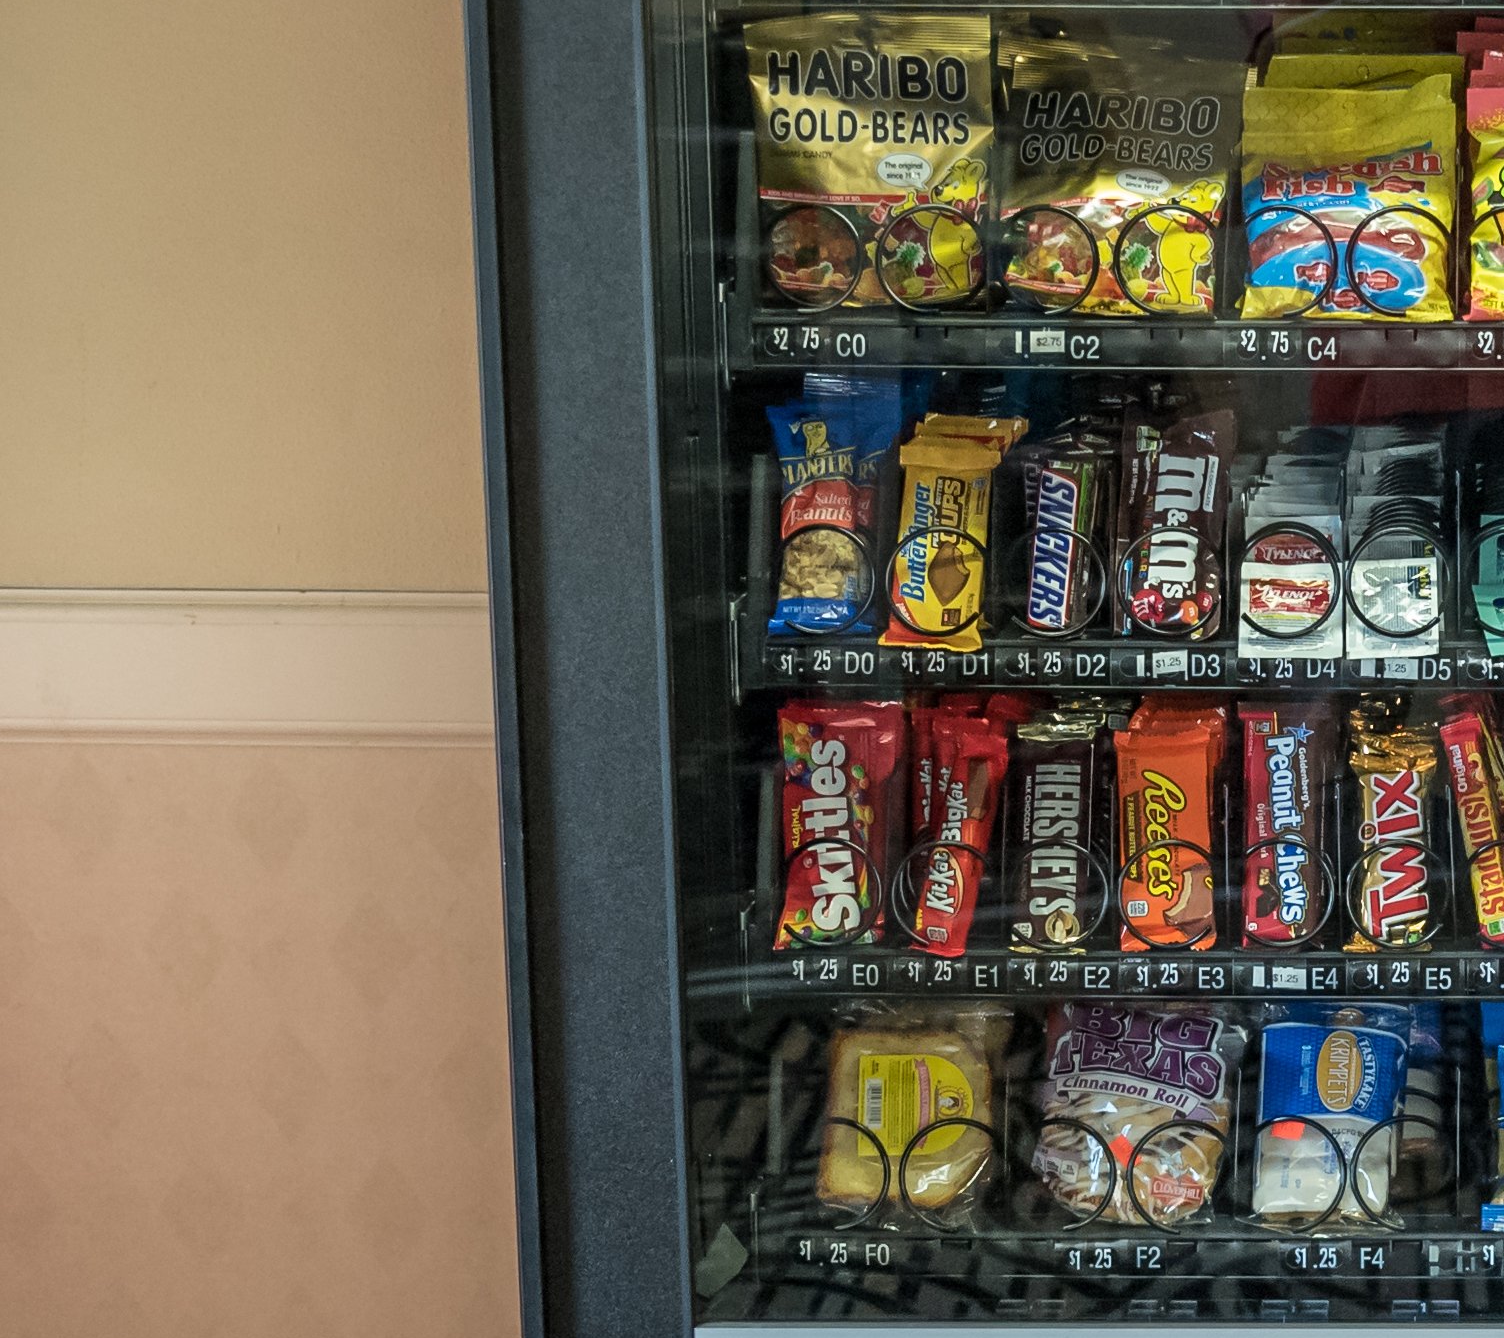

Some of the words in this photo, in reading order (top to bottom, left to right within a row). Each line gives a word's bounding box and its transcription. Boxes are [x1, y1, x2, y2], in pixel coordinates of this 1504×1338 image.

[766, 48, 969, 103] HARIBO
[1024, 92, 1220, 136] HARIBO
[769, 108, 971, 146] GOLD-BEARS
[1020, 134, 1213, 171] GOLD-BEARS
[884, 162, 897, 170] The
[898, 162, 923, 171] original
[886, 172, 903, 180] since
[1262, 175, 1356, 202] Fish
[836, 333, 866, 358] C0
[1036, 336, 1062, 348] $2.75
[1070, 335, 1099, 359] C2
[1307, 337, 1337, 361] C4
[782, 454, 853, 485] PLANTERS
[814, 493, 851, 506] Salted
[940, 479, 963, 541] CUPS
[790, 502, 853, 527] Peanuts
[1029, 469, 1078, 627] SNICKERS
[845, 652, 874, 674] D0
[963, 655, 989, 675] D1
[1077, 655, 1105, 677] D2
[1156, 657, 1181, 668] $1.25
[1192, 655, 1220, 677] D3
[1307, 657, 1336, 678] D4
[1422, 659, 1451, 680] D5
[1266, 734, 1304, 831] Peanut
[1298, 747, 1311, 811] Goldenberg's
[1022, 794, 1032, 841] CHOCOLATE
[1255, 802, 1268, 837] Original
[802, 739, 860, 930] Skittles
[1029, 763, 1081, 917] HERSHEY'S
[1142, 768, 1186, 901] Reese's
[1360, 769, 1429, 942] TWIX
[1275, 833, 1309, 925] Chews
[852, 965, 879, 986] E0
[975, 966, 998, 987] E1
[1084, 968, 1111, 989] E2
[1198, 968, 1225, 989] E3
[1272, 974, 1299, 984] $1.25
[1312, 968, 1338, 989] E4
[1425, 968, 1452, 989] E5
[1077, 1005, 1220, 1050] BIG
[1051, 1037, 1223, 1097] TEXAS
[1327, 1037, 1349, 1106] KRIMPETS
[1353, 1038, 1377, 1110] TASTYKAKE
[1062, 1076, 1150, 1099] Cinnamon
[1153, 1086, 1190, 1110] Roll
[1152, 1180, 1201, 1201] CLOVERHILL
[866, 1244, 890, 1265] F0
[1070, 1248, 1112, 1270] $1.25
[1137, 1247, 1161, 1268] F2
[1294, 1247, 1338, 1269] $1.25
[1360, 1249, 1385, 1269] F4
